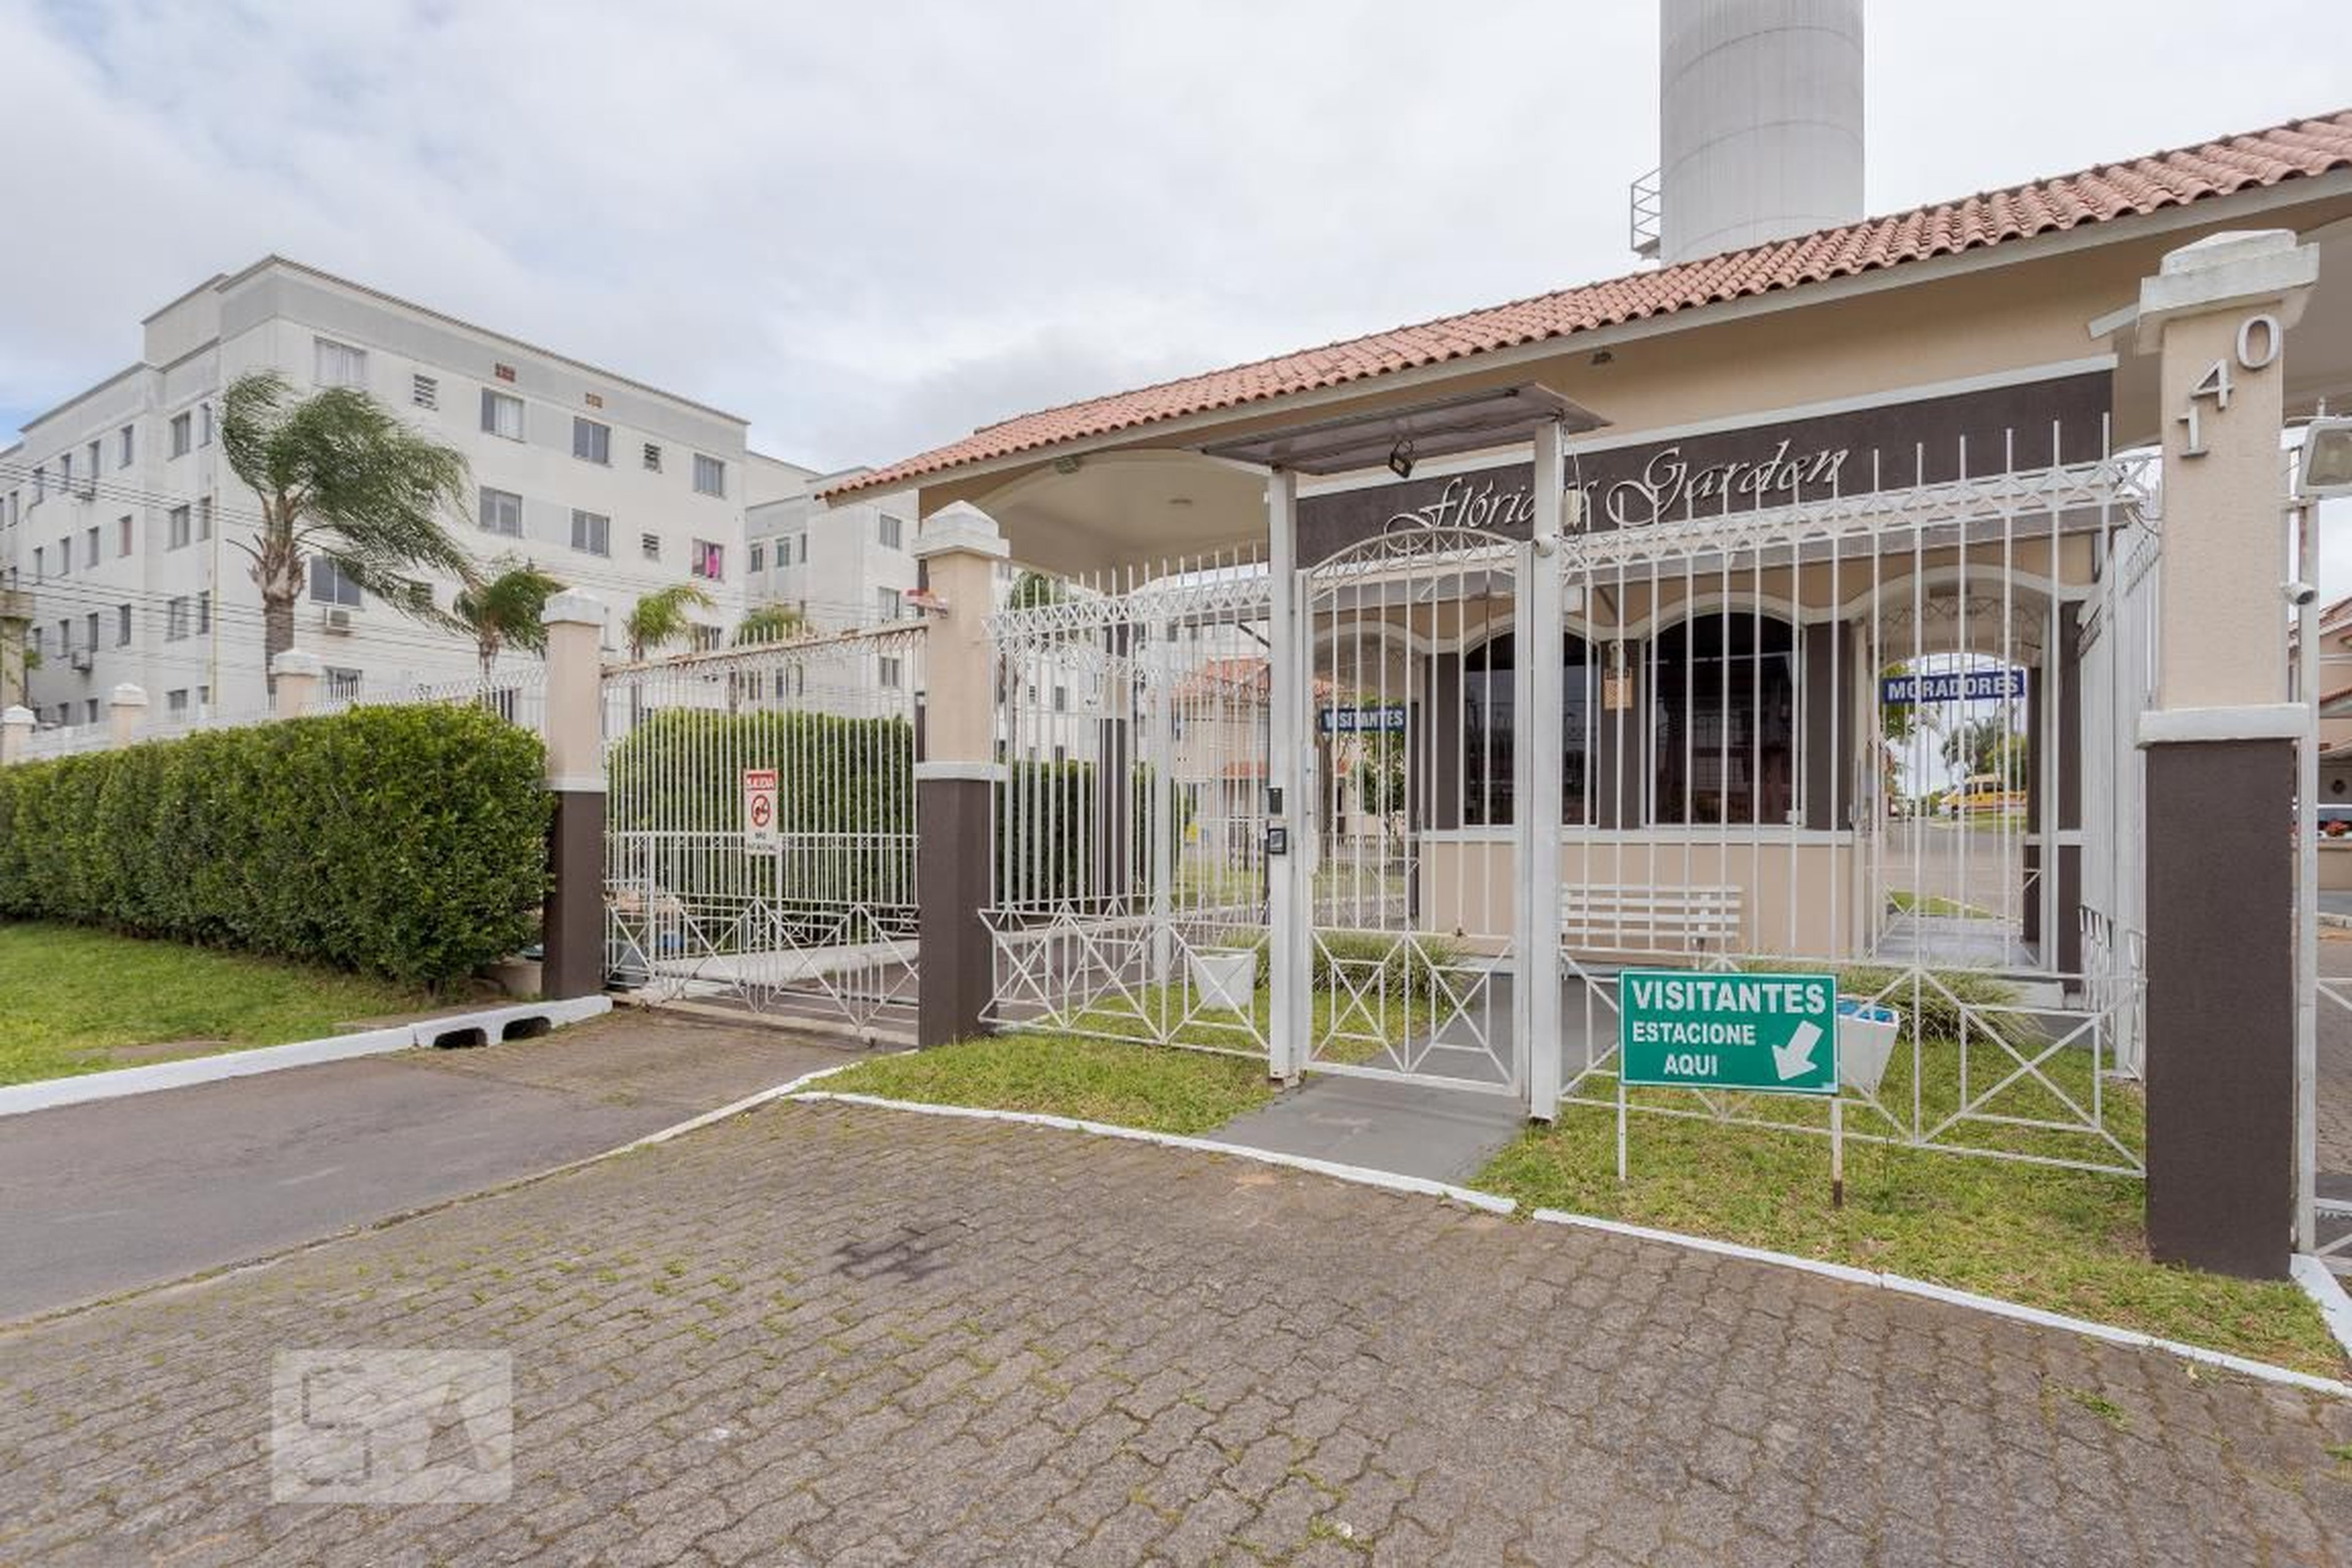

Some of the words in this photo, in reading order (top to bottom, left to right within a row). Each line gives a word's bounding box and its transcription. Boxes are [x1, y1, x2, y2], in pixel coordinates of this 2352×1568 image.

[2175, 314, 2280, 458] 140
[1606, 438, 1849, 527] Garden
[1887, 676, 2019, 699] MORADORES
[1324, 709, 1404, 729] VSITANTES
[1631, 979, 1826, 1014] VISITANTES
[1632, 1021, 1757, 1046] ESTACIONE
[1663, 1054, 1718, 1077] AQUI
